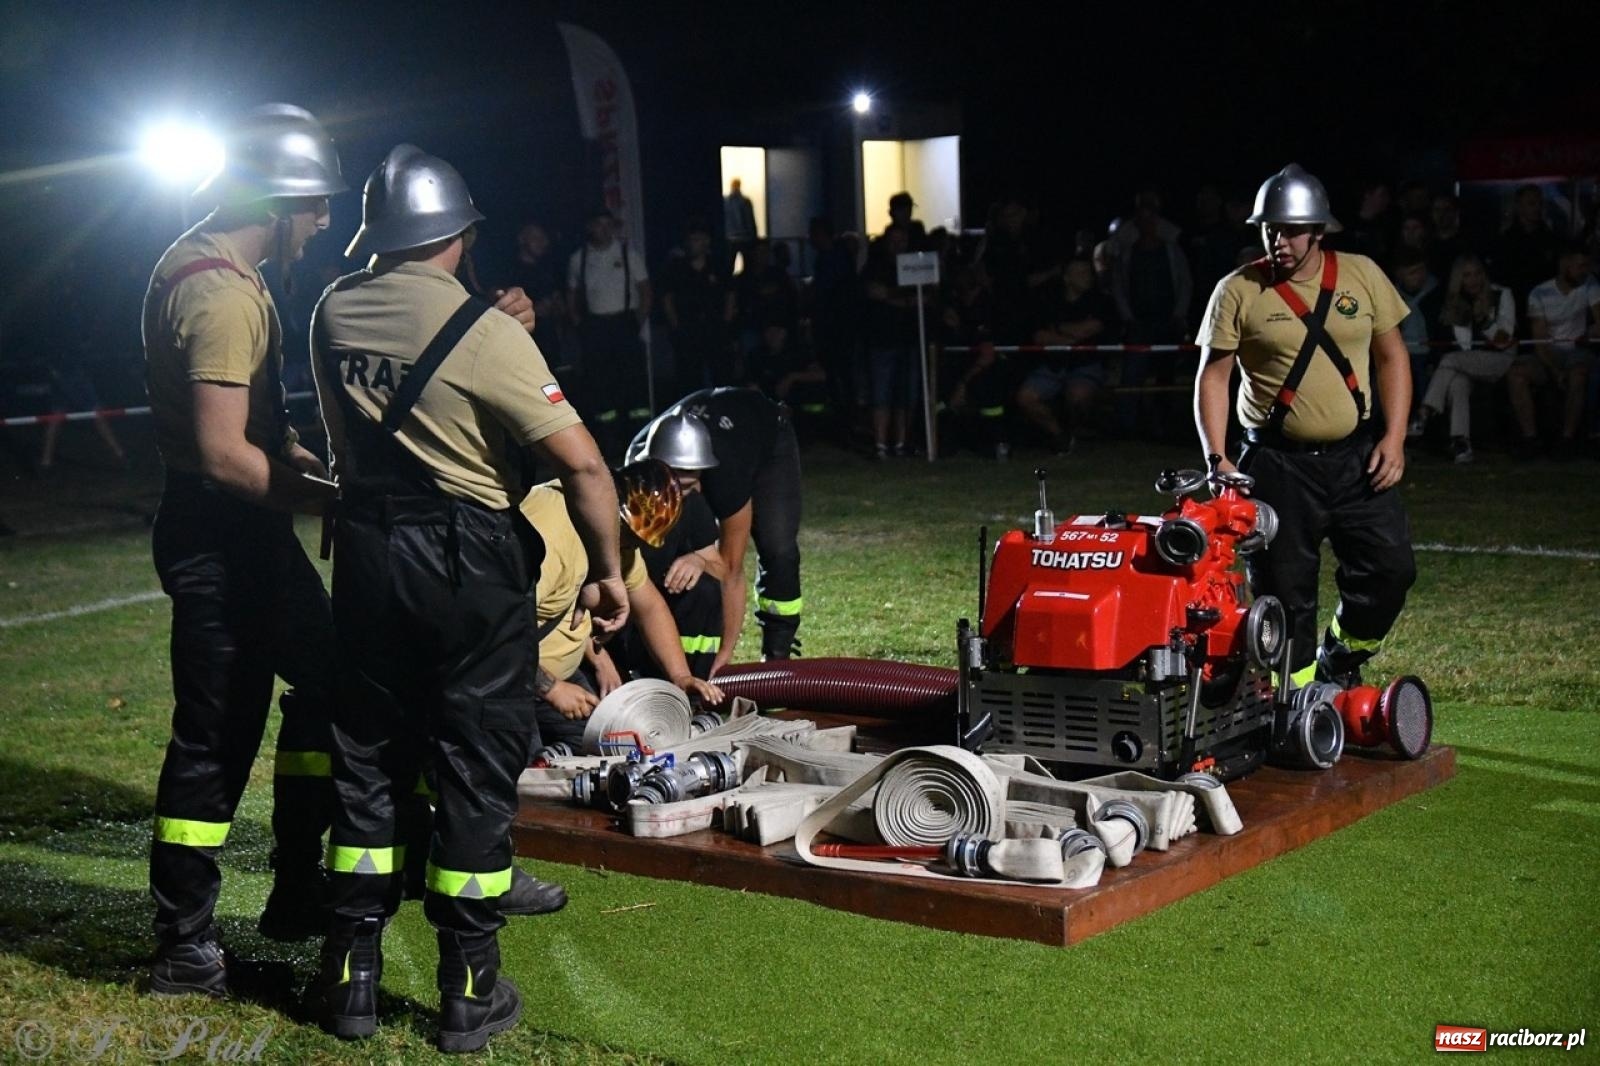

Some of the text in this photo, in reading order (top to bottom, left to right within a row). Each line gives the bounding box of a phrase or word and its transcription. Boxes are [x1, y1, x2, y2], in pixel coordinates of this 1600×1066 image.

[1060, 531, 1088, 541] 567
[1100, 532, 1119, 543] 52
[1031, 549, 1124, 569] TOHATSU
